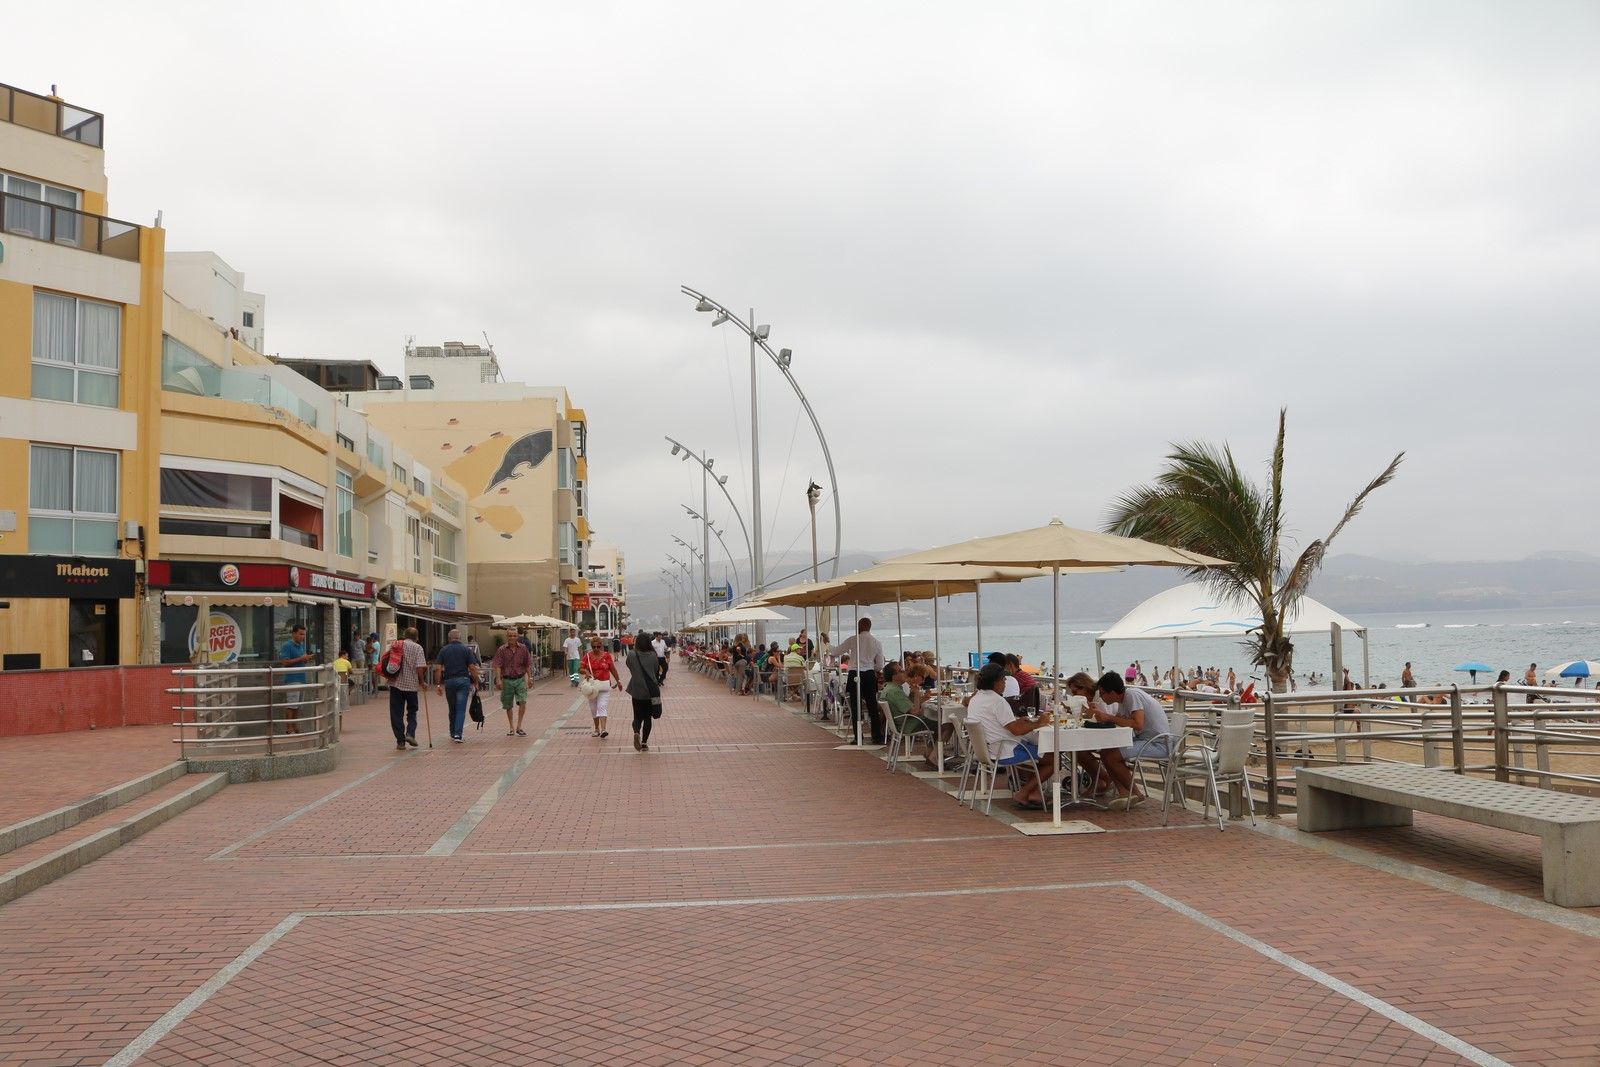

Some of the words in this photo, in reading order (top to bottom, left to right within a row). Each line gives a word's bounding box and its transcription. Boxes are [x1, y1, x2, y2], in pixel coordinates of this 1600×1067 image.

[56, 563, 109, 577] Mahou
[209, 625, 235, 638] RGER
[209, 635, 236, 652] ING
